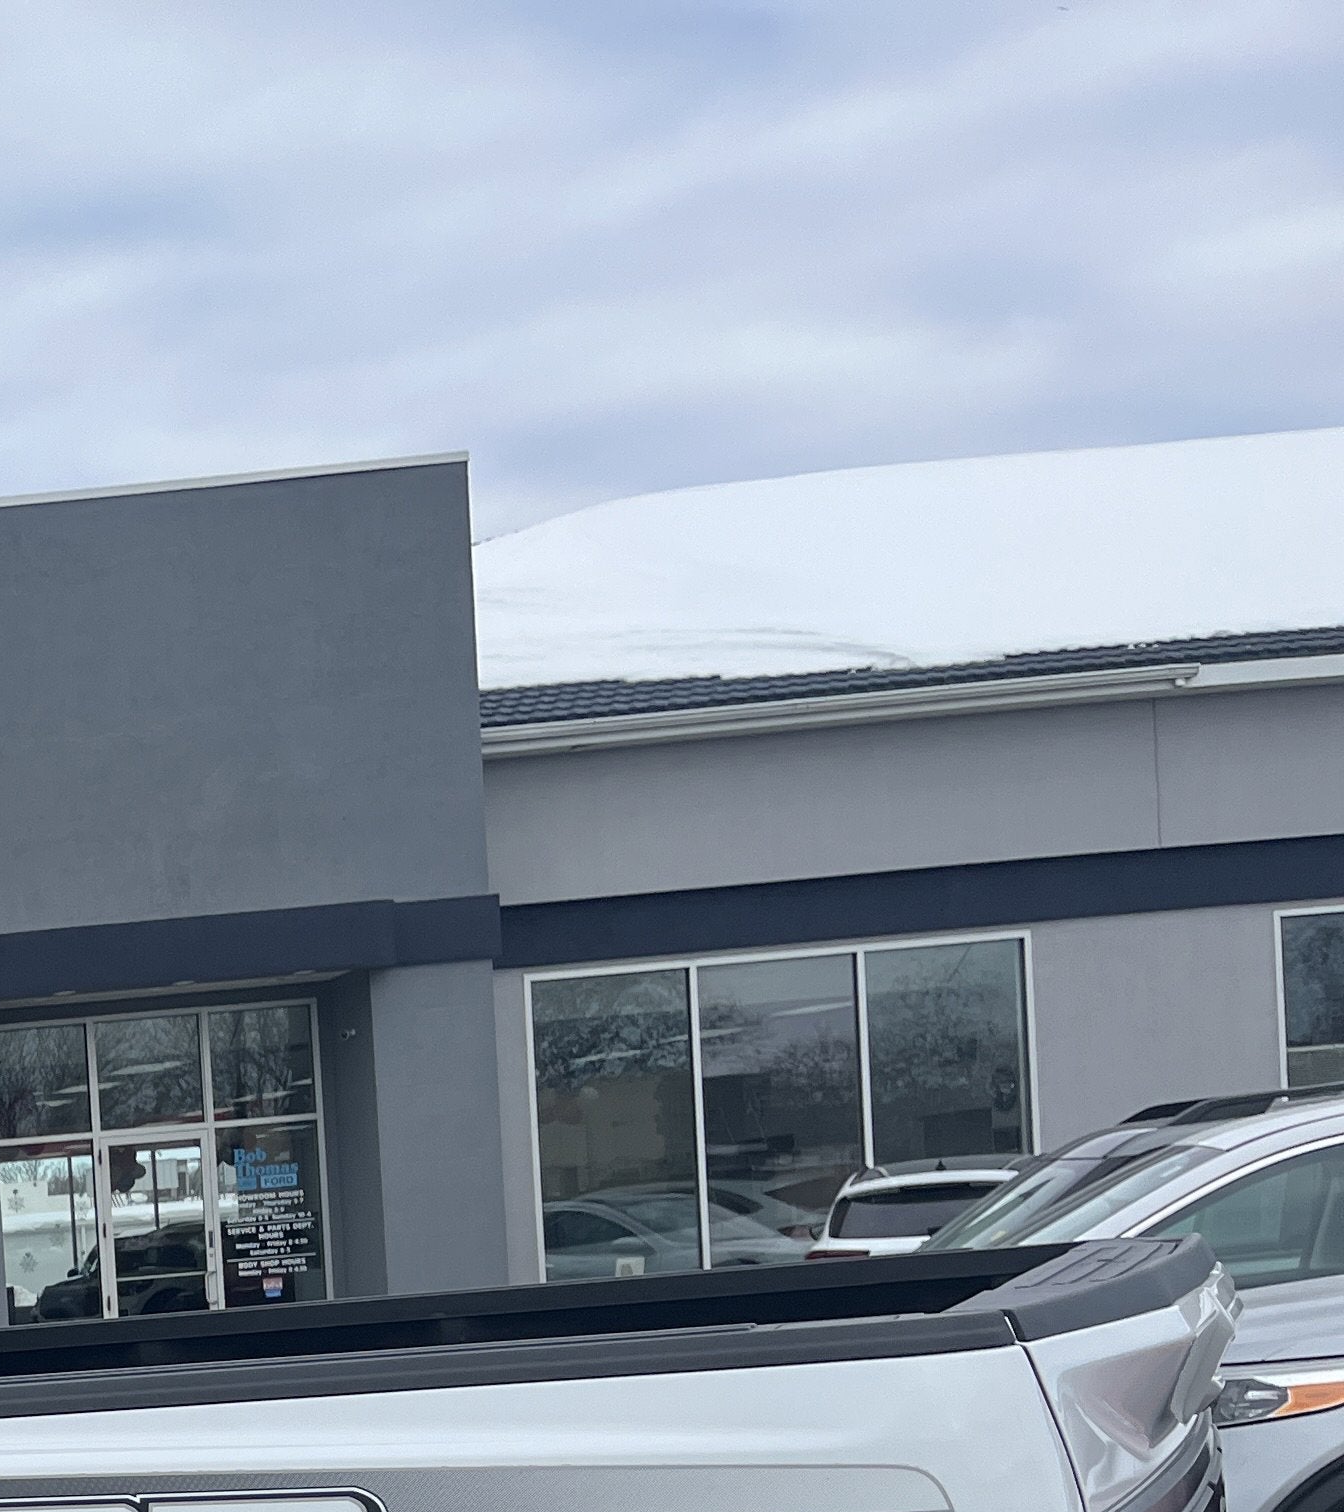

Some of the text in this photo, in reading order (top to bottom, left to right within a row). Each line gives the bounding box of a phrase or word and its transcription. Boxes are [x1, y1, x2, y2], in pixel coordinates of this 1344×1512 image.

[233, 1147, 267, 1163] Bob
[236, 1162, 299, 1178] Thomas
[264, 1175, 294, 1186] FORD
